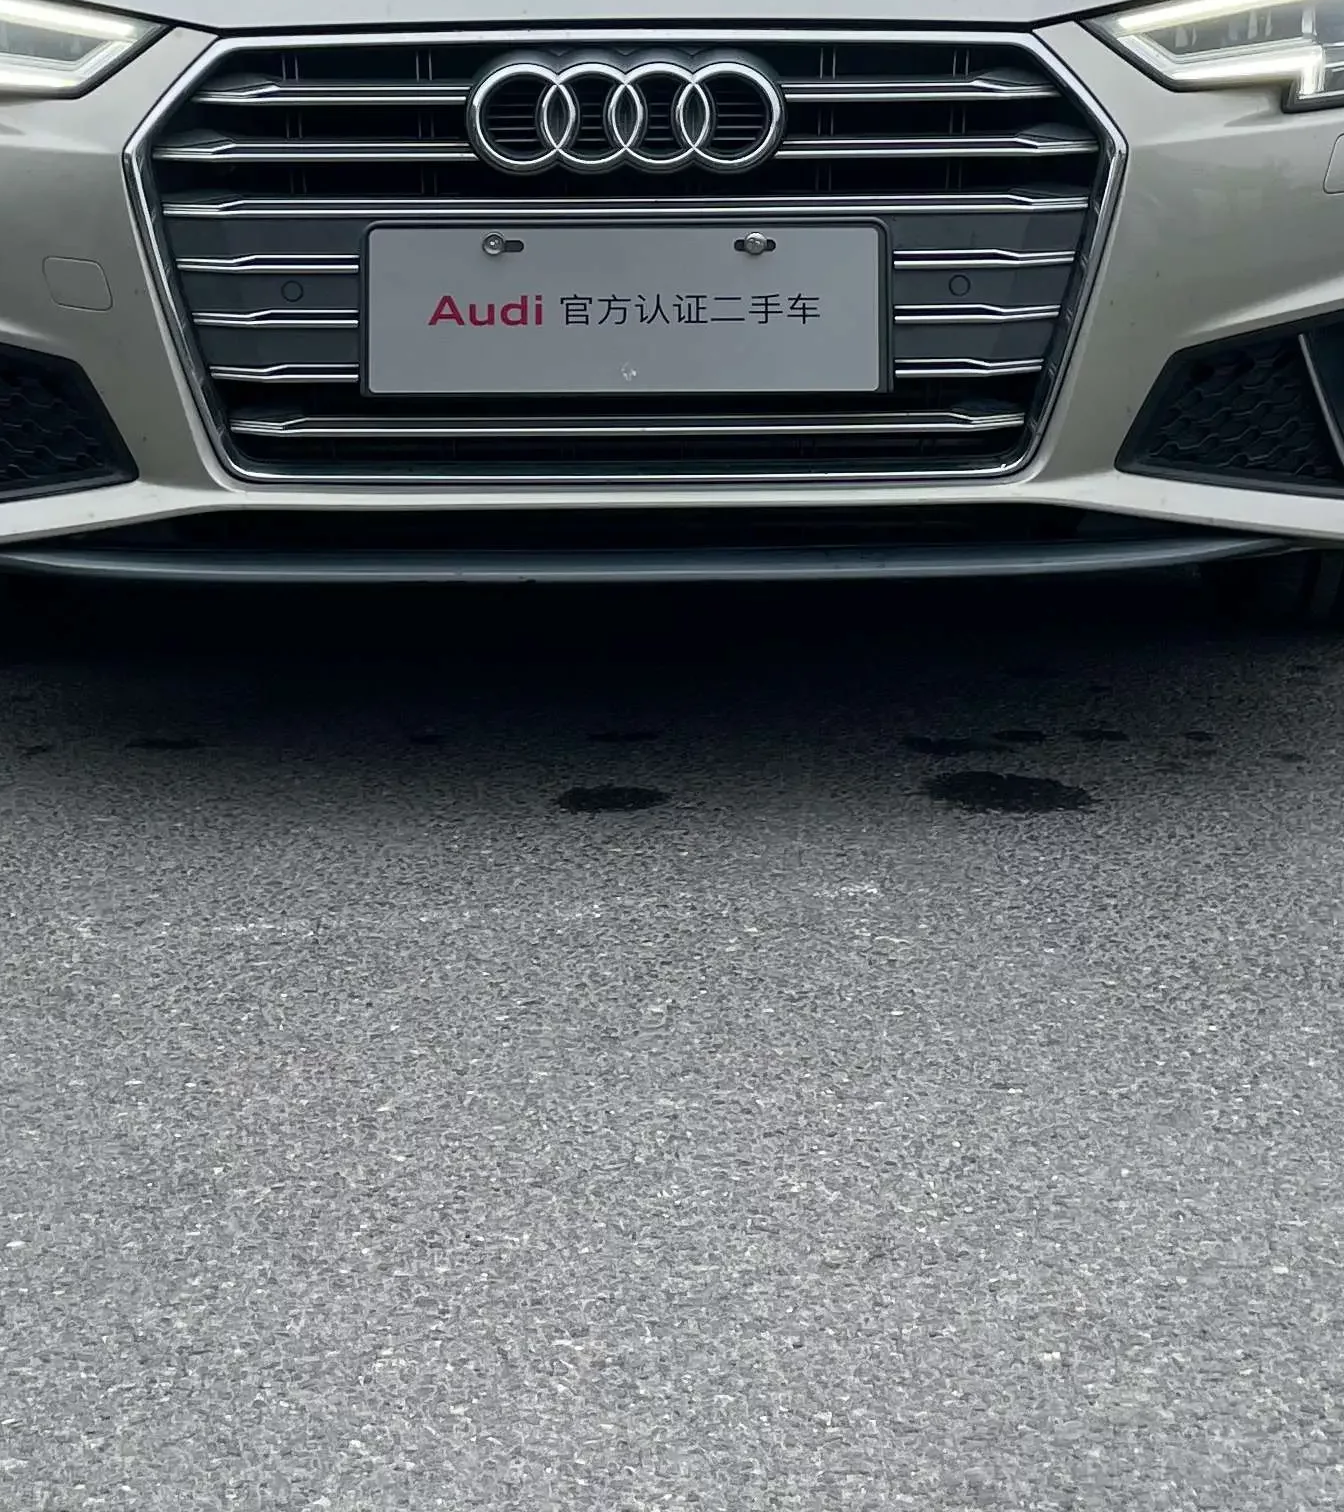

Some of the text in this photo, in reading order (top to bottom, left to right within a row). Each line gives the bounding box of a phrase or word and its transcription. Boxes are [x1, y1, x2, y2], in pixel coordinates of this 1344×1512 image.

[428, 293, 822, 326] Audi 官方认证二手车
